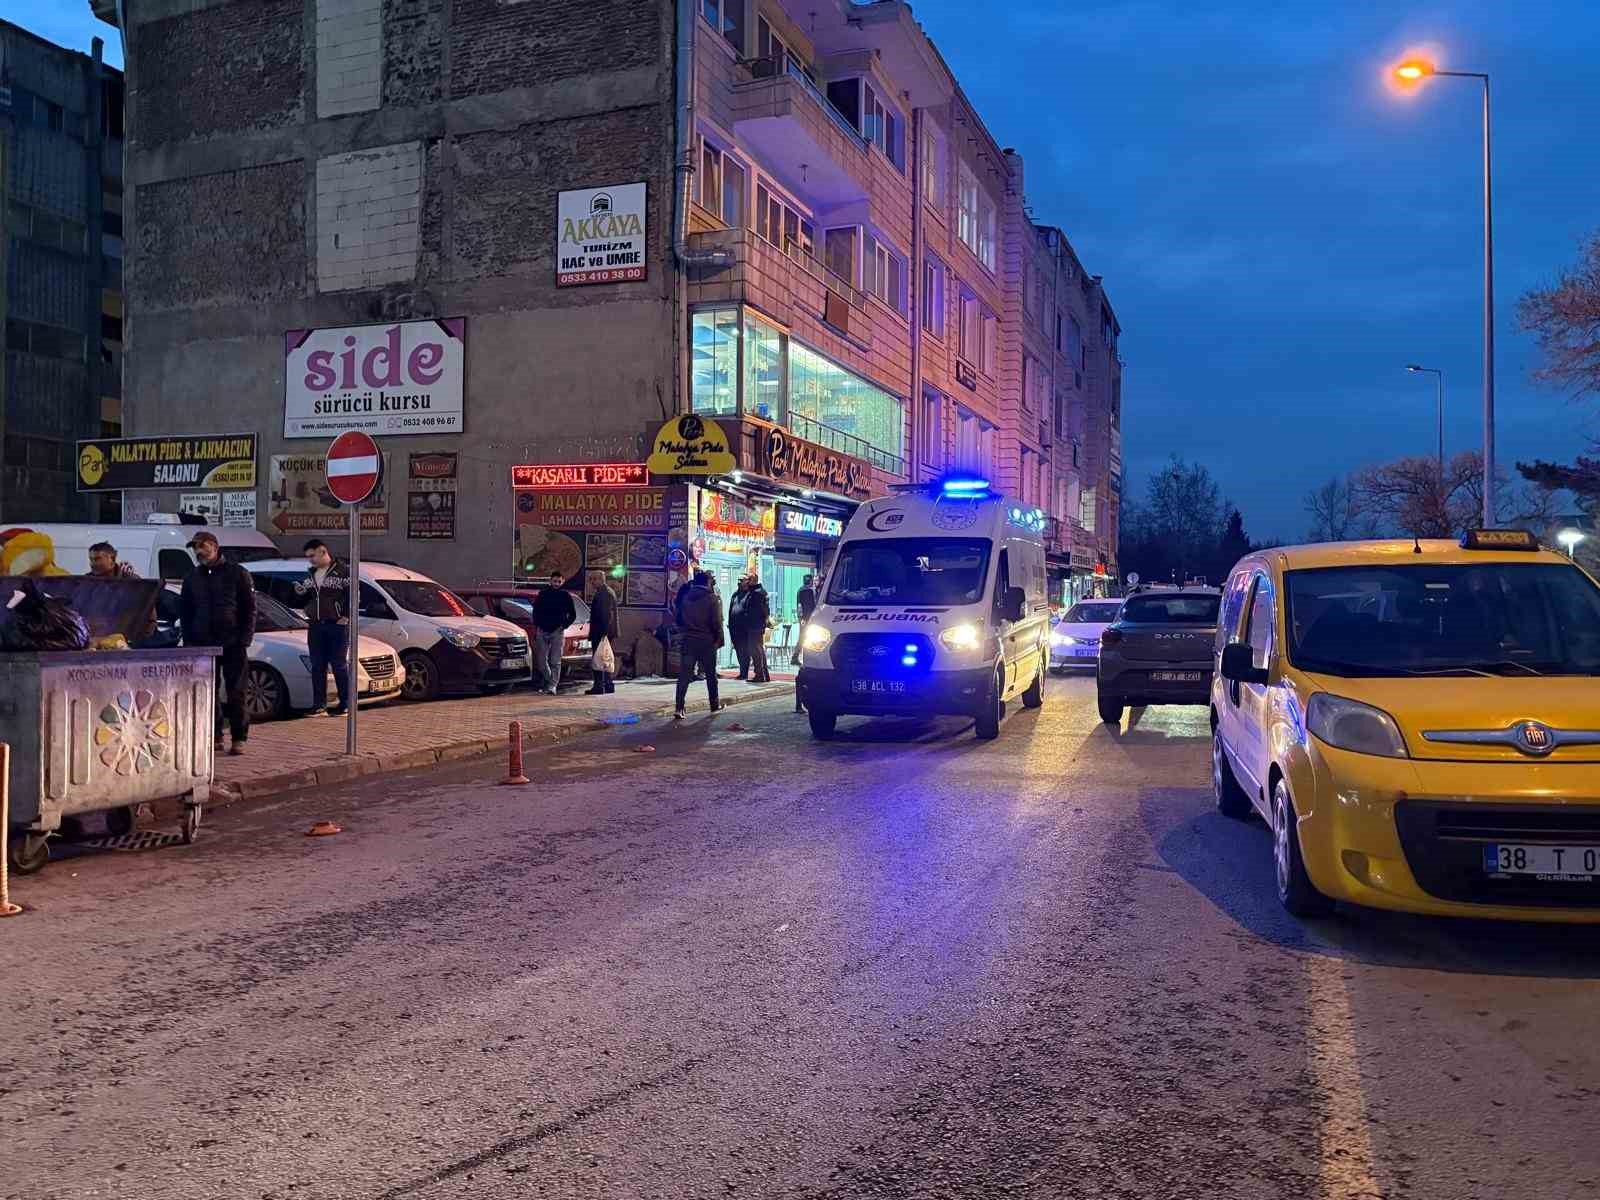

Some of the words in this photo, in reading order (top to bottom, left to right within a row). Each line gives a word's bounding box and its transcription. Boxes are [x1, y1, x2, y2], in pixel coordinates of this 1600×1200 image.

[561, 214, 642, 246] AKKAYA
[583, 241, 632, 253] TURİZM
[562, 256, 585, 269] HAC
[606, 251, 641, 265] UMRE
[561, 273, 586, 283] 0533
[590, 272, 609, 280] 410
[611, 271, 625, 279] 38
[627, 269, 641, 278] 00
[304, 324, 444, 391] side
[314, 393, 373, 414] sürücü
[379, 391, 431, 411] kursu
[403, 418, 420, 426] 0532
[422, 417, 435, 426] 408
[436, 417, 446, 425] 96
[111, 443, 157, 462] MALATYA
[195, 439, 251, 460] LAHMACUN
[153, 463, 200, 483] SALONU
[279, 457, 313, 473] KÜÇÜK
[541, 494, 618, 511] MALATYA
[624, 490, 664, 510] PİDE
[542, 514, 610, 526] LAHMACUN
[613, 514, 662, 526] SALONU
[785, 511, 817, 532] SALON
[1526, 729, 1545, 744] FIAT
[1499, 848, 1527, 870] 38
[1553, 849, 1565, 871] T
[1584, 849, 1600, 872] 0
